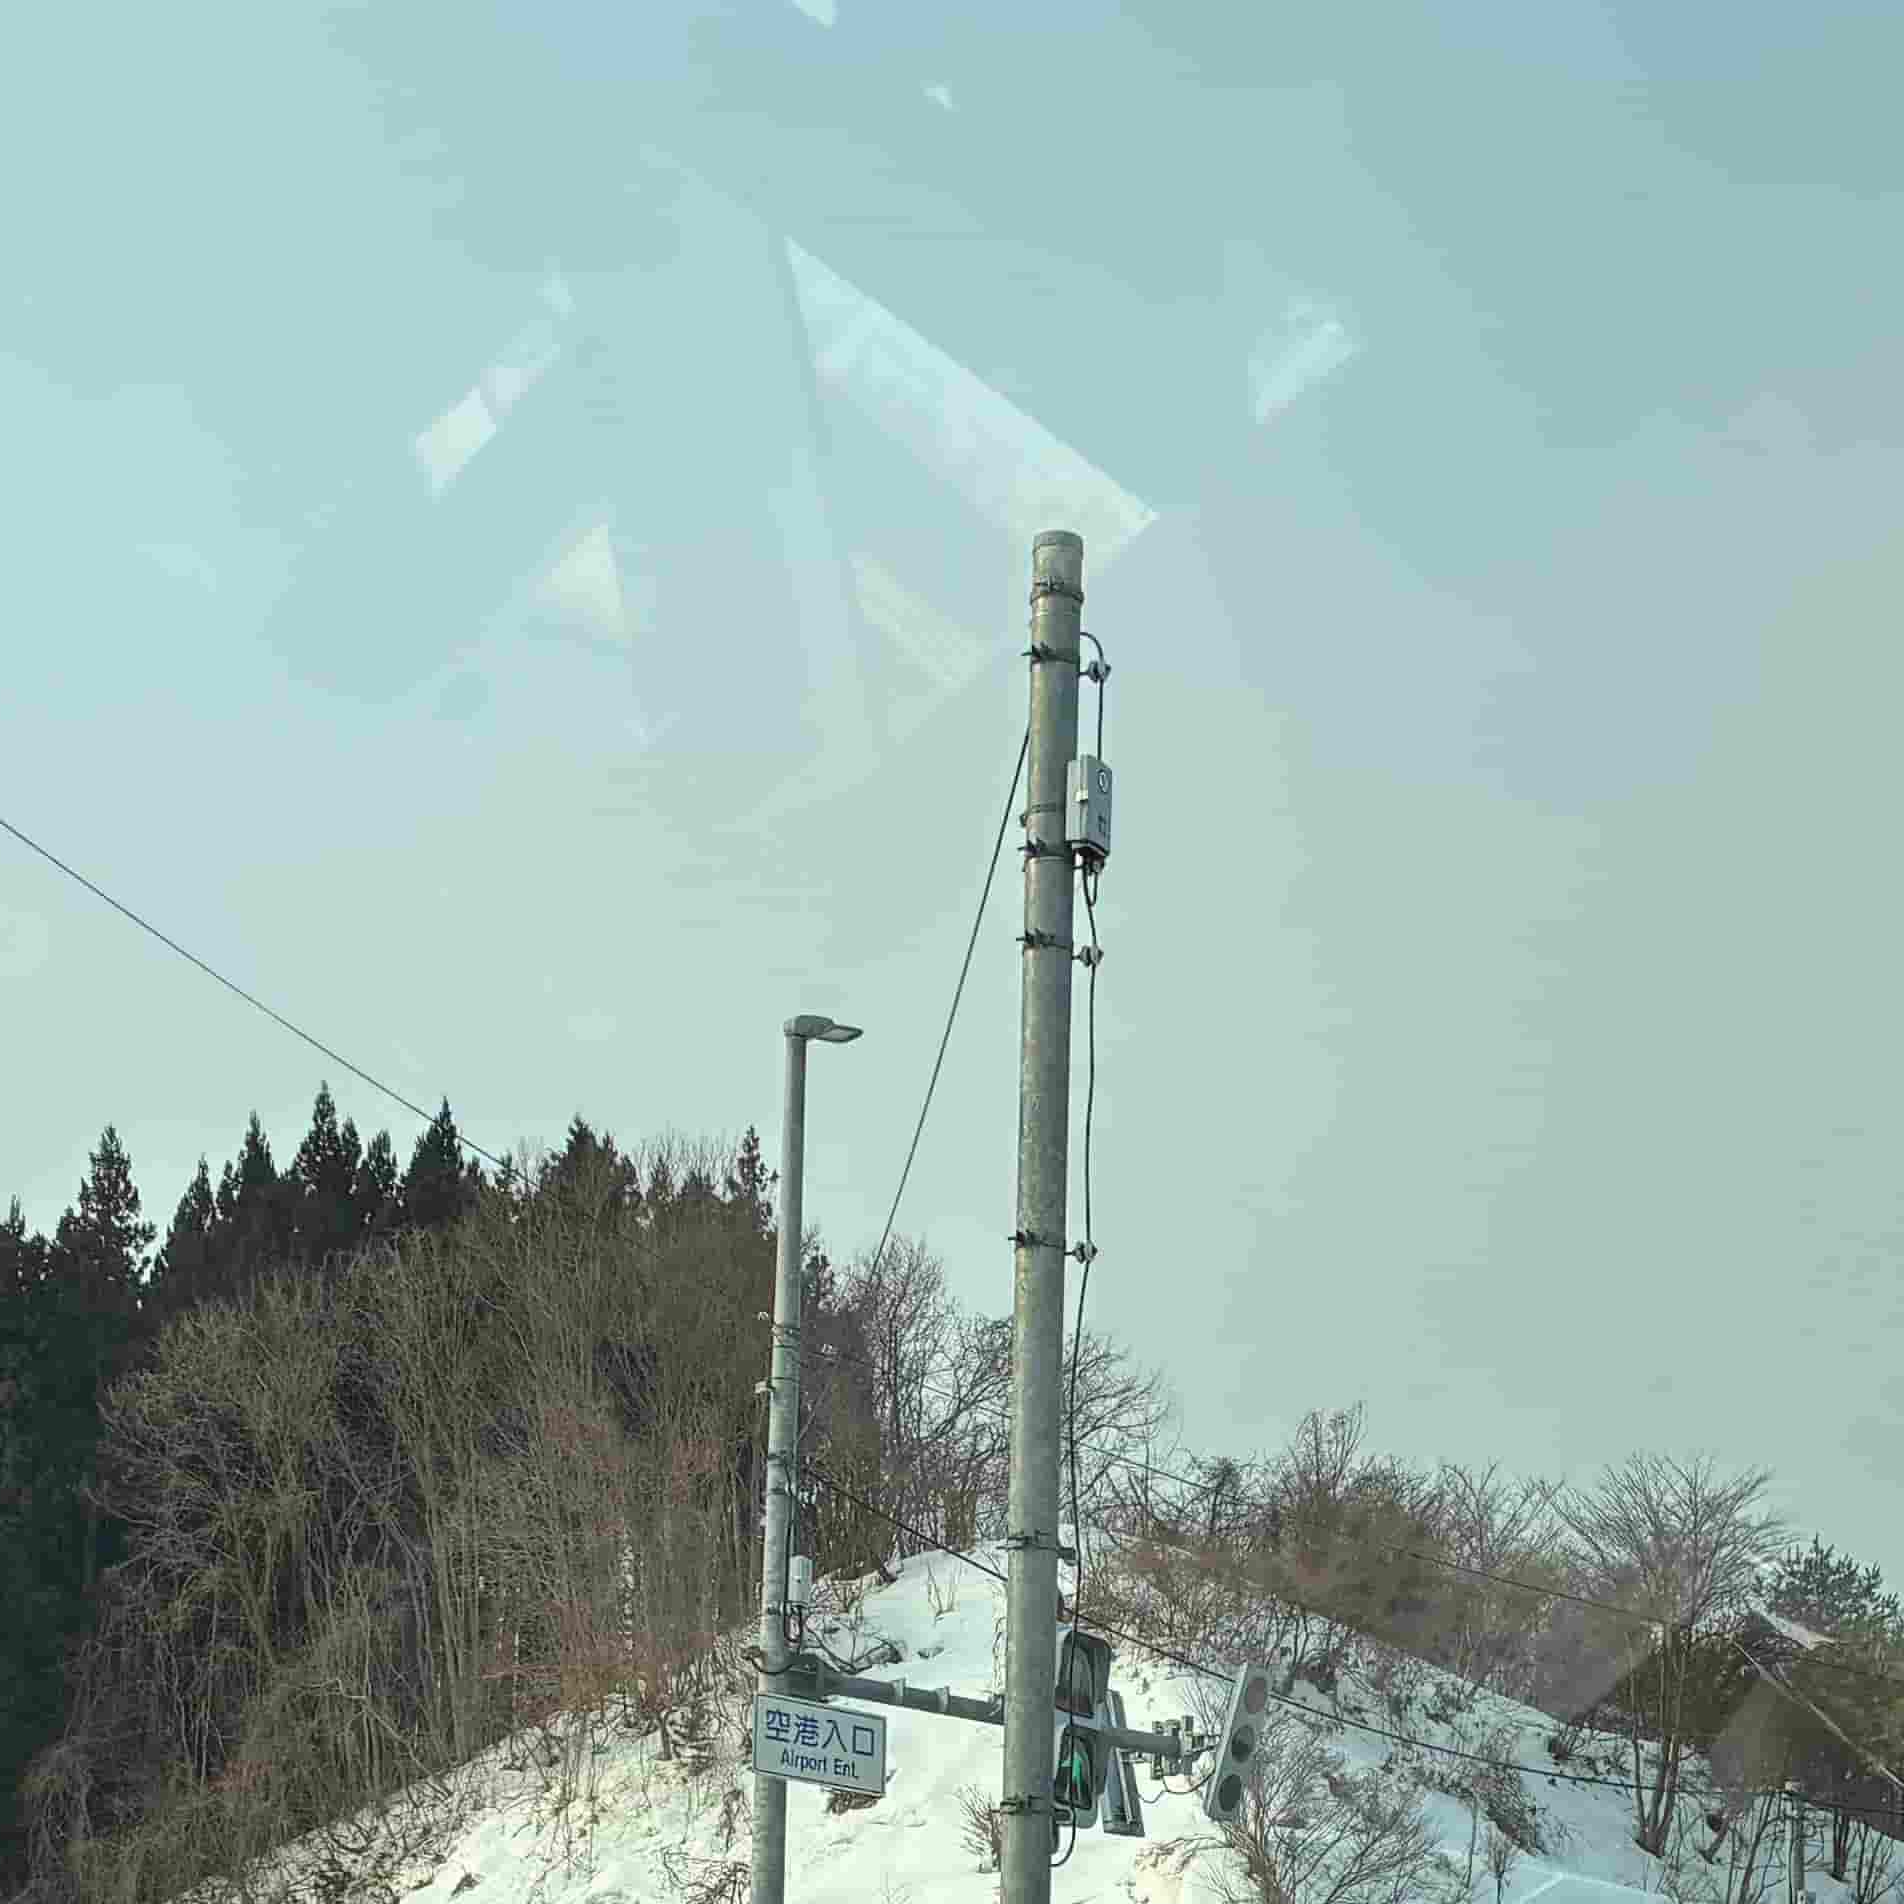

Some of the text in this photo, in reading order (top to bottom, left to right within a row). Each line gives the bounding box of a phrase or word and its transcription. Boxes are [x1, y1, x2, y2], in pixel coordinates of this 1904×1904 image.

[765, 1709, 874, 1756] 空港入口
[780, 1748, 828, 1773] Airport
